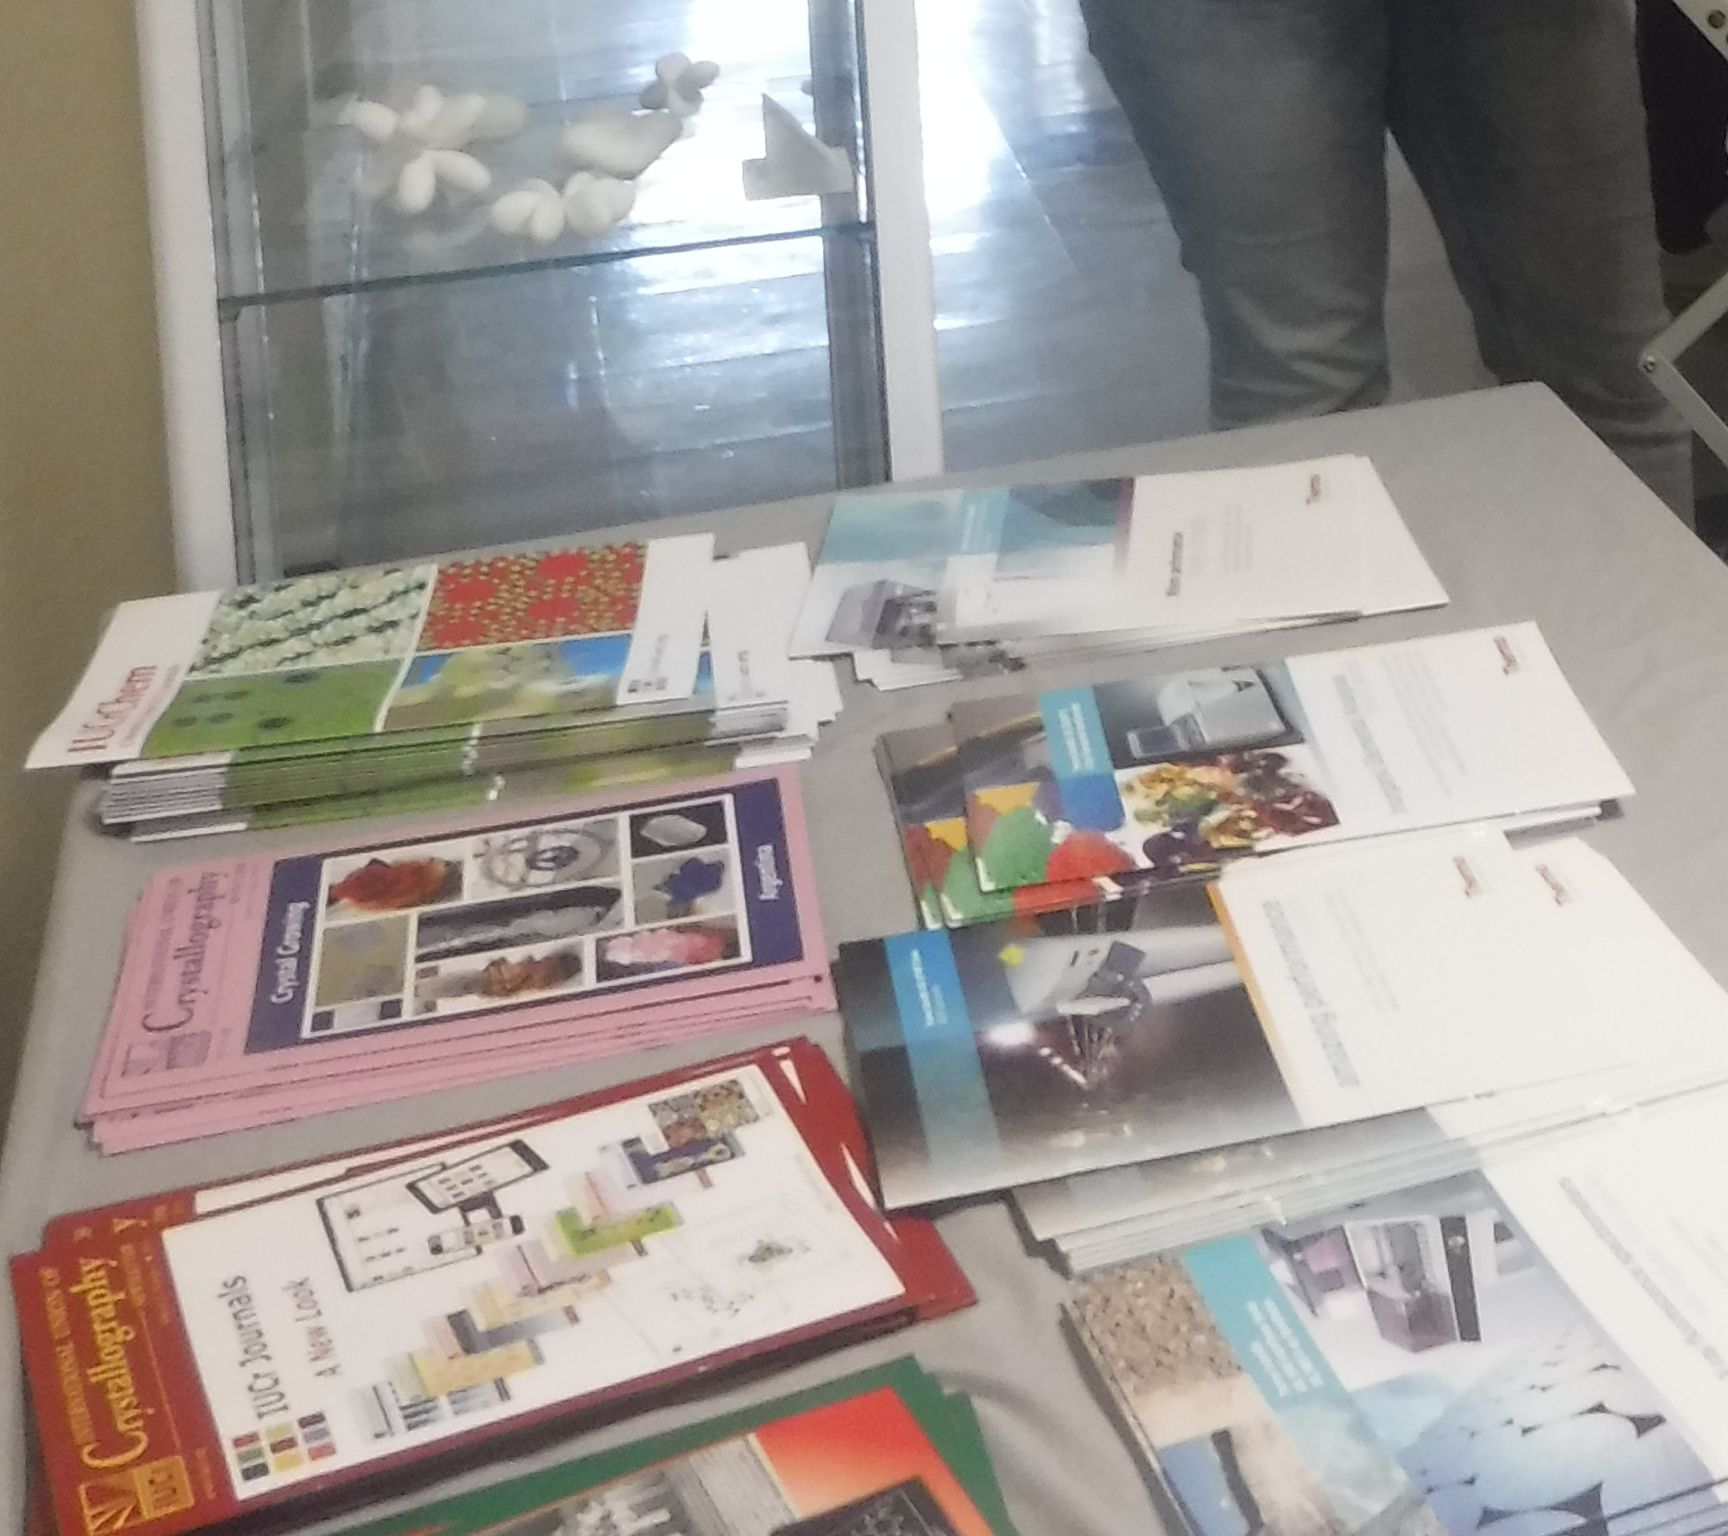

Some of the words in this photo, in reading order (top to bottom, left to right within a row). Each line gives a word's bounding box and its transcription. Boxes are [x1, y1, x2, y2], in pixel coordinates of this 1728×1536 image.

[142, 871, 229, 1032] Crystallography
[217, 1274, 273, 1368] Journals
[281, 1277, 323, 1322] Look
[306, 1326, 335, 1362] New
[69, 1257, 154, 1469] Crystallography
